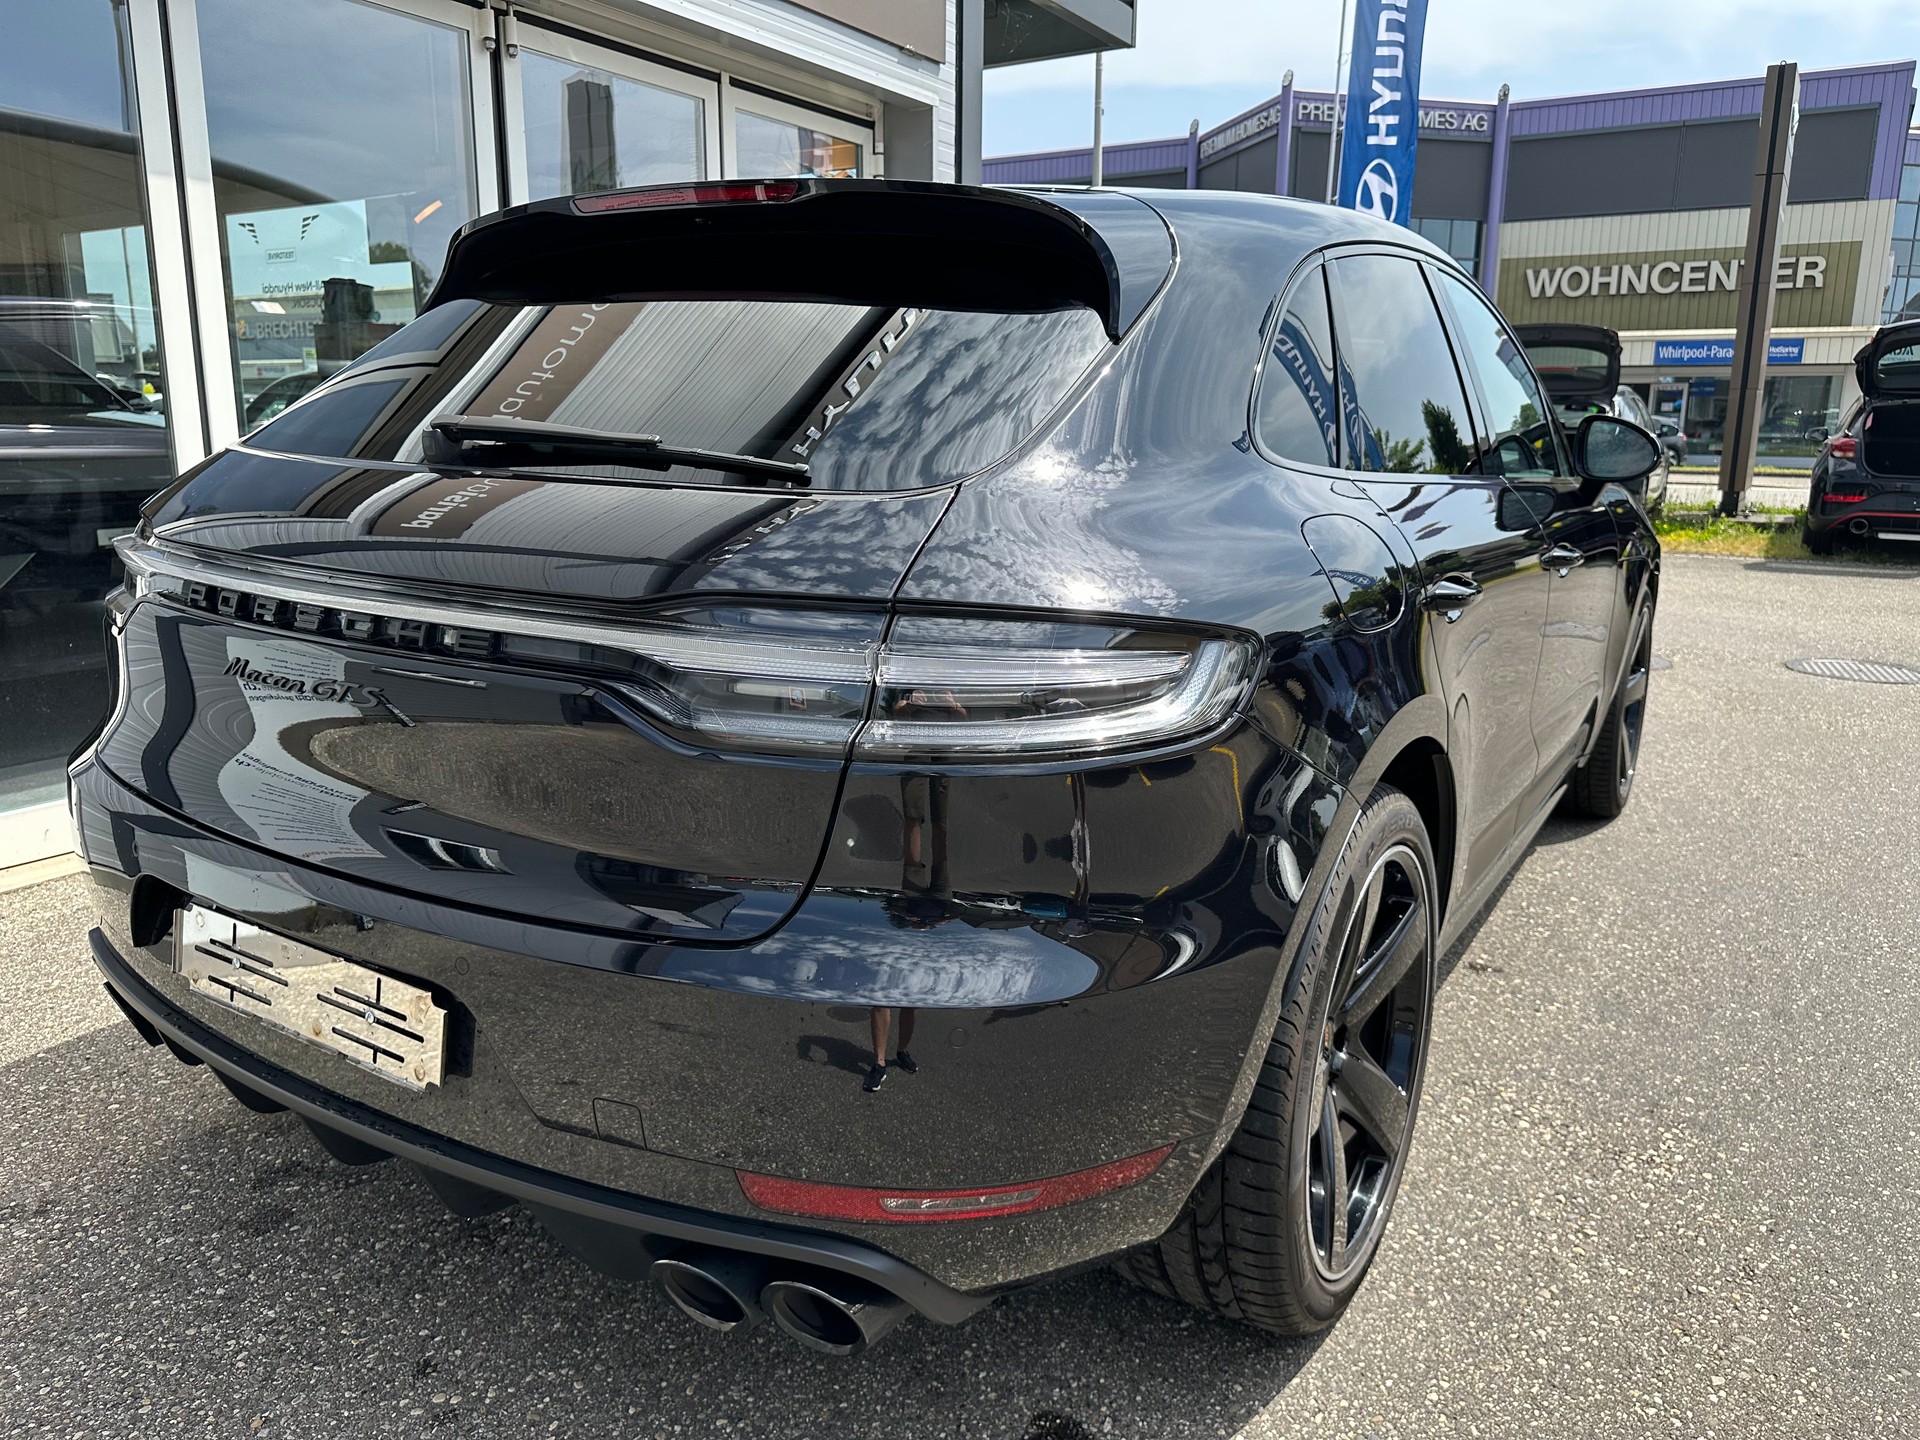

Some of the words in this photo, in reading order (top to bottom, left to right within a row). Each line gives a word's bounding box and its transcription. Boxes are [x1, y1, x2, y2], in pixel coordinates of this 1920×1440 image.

[1366, 0, 1408, 146] HYUN
[1200, 127, 1236, 159] PREMIUM
[1236, 112, 1268, 141] HOMES
[1418, 110, 1457, 130] MES
[1461, 112, 1488, 131] AG
[1526, 255, 1827, 298] WOHNCENER
[1659, 345, 1734, 361] Whirlpool-Para
[187, 583, 494, 656] PORSCHE
[223, 656, 307, 695] Macan
[310, 678, 386, 708] GTS
